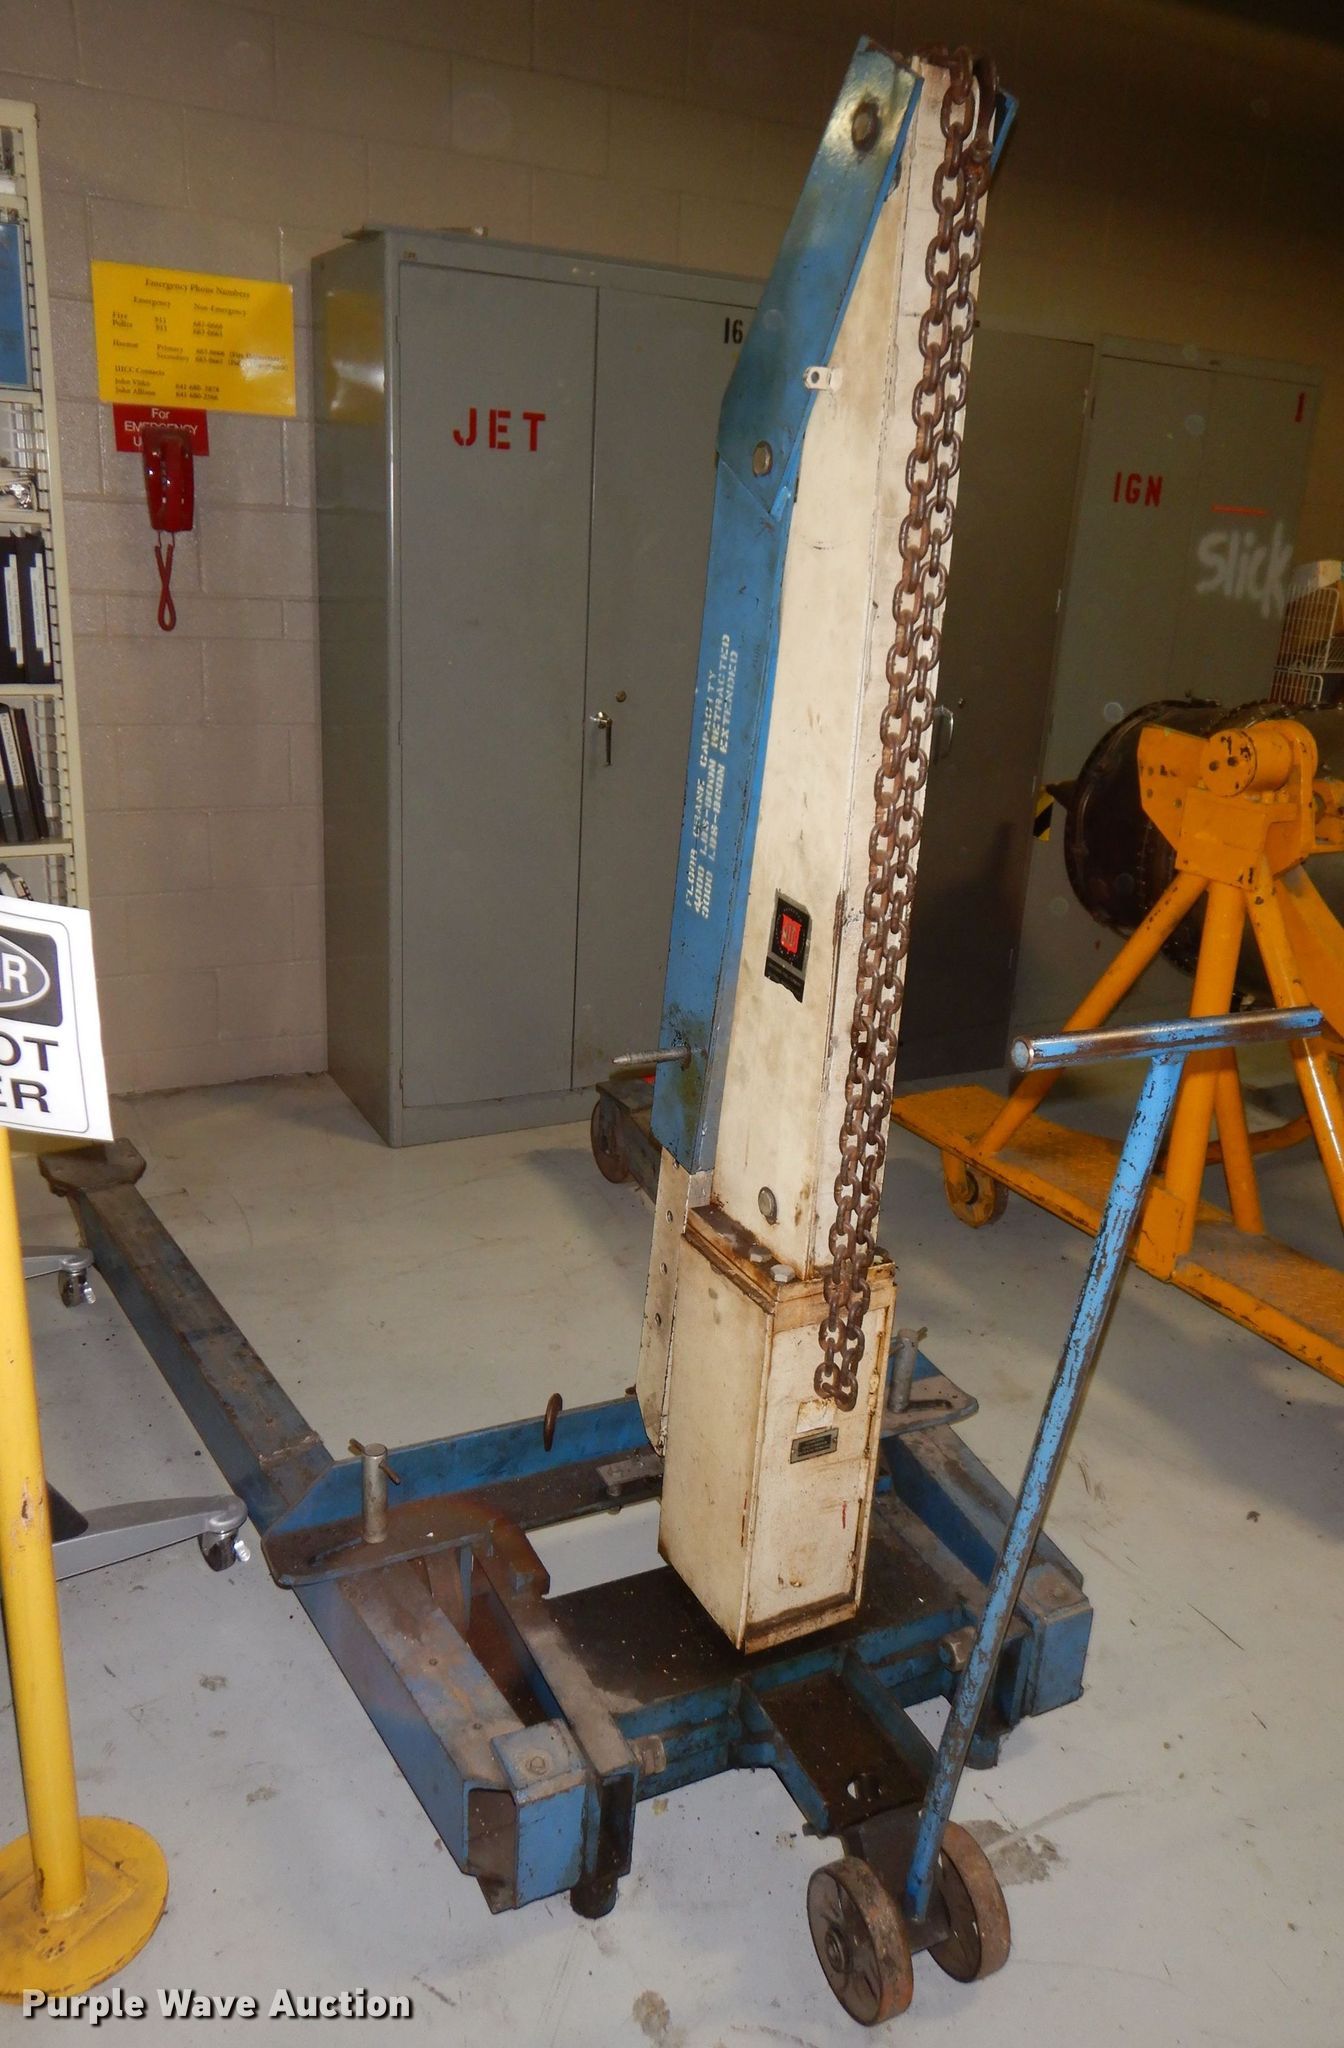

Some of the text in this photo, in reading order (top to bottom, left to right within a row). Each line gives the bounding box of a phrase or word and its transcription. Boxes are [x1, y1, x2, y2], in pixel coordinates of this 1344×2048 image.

[145, 278, 250, 299] Emergency Phone Numbers
[151, 408, 170, 419] For
[453, 407, 546, 452] JET
[1113, 472, 1163, 507] IGN
[710, 634, 730, 748] RETRACTED
[719, 650, 738, 754] EXTENDED
[685, 669, 717, 907] FLOOR CRANE CAPACITY
